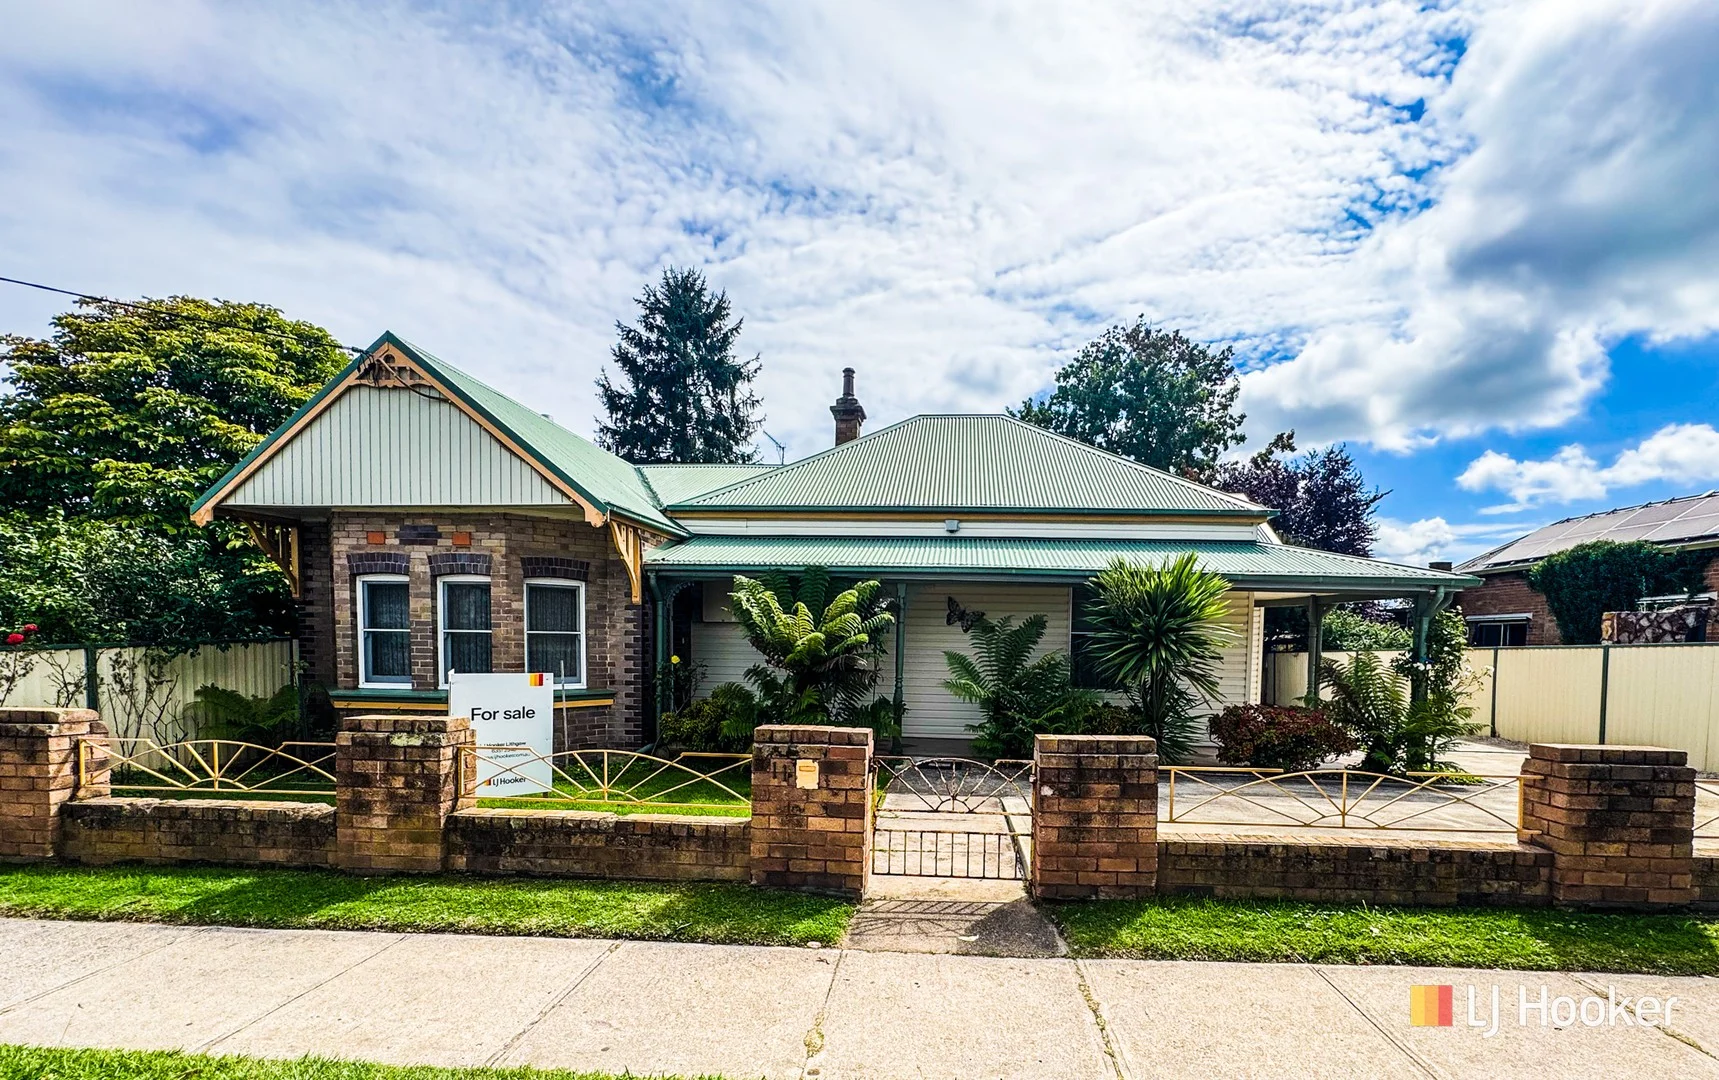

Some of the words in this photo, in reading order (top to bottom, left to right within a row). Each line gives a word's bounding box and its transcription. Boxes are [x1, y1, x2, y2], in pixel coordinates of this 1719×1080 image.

[471, 707, 499, 721] For
[503, 706, 536, 720] sale
[492, 778, 499, 787] LJ
[500, 776, 526, 785] Hooker
